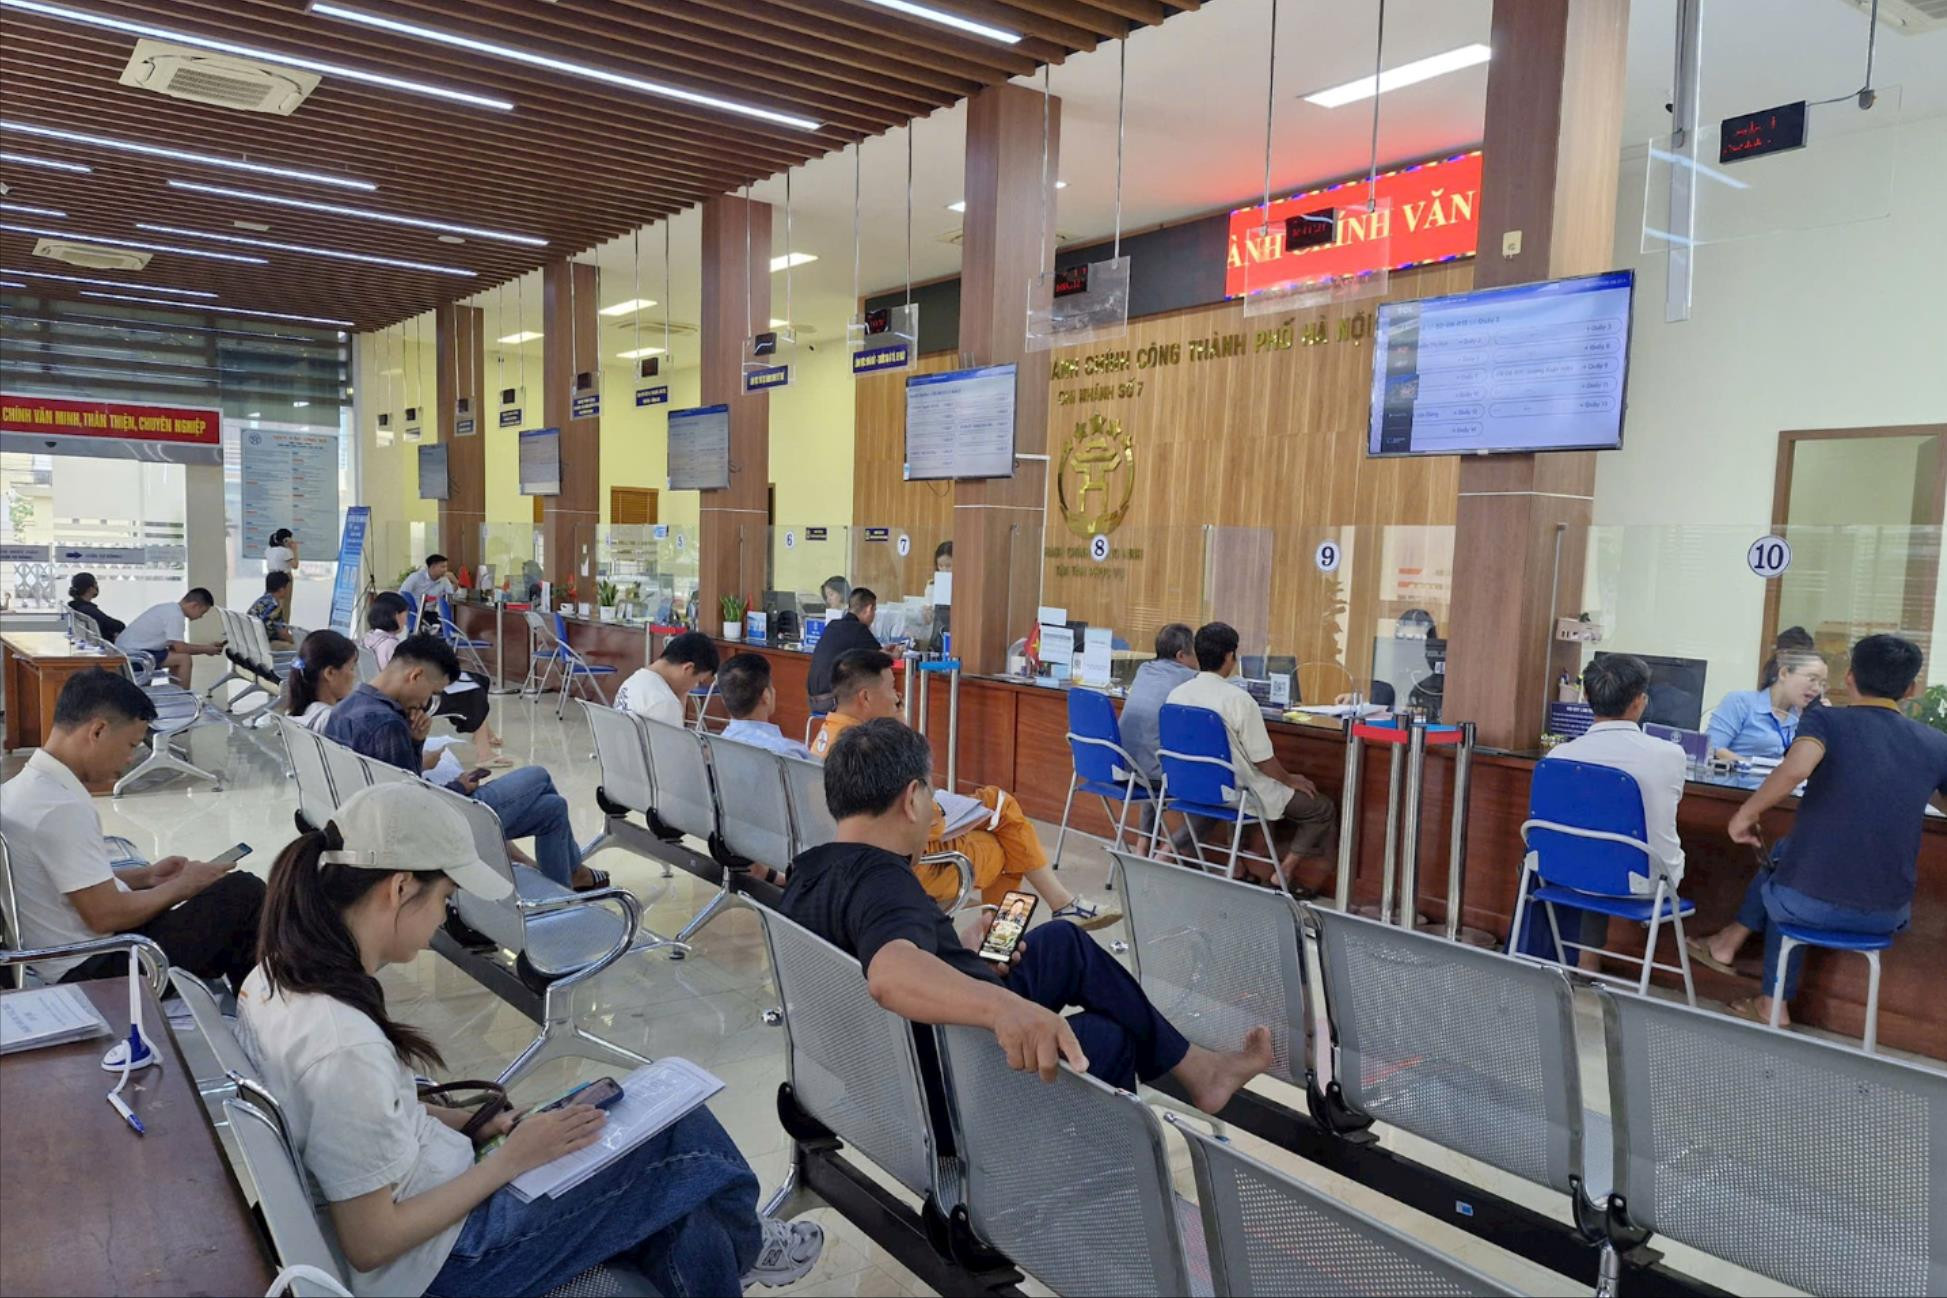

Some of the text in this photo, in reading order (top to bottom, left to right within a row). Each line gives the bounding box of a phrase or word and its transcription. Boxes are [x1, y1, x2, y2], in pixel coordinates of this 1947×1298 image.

[1290, 208, 1393, 256] ÍNH
[1402, 188, 1477, 233] VĂN
[1084, 347, 1130, 376] CHÍNH
[1136, 342, 1181, 369] CÔNG
[1188, 331, 1247, 362] THÀNH
[1255, 316, 1296, 353] PHỐ
[1302, 314, 1329, 347] HÀ
[1337, 310, 1373, 347] NỘI
[1118, 376, 1136, 399] SỐ
[1137, 381, 1144, 397] 7
[2, 405, 32, 422] CHÍNH
[786, 533, 793, 546] 6
[900, 537, 907, 553] 7
[1094, 539, 1105, 557] 8
[1321, 546, 1335, 567] 9
[1754, 543, 1784, 570] 10
